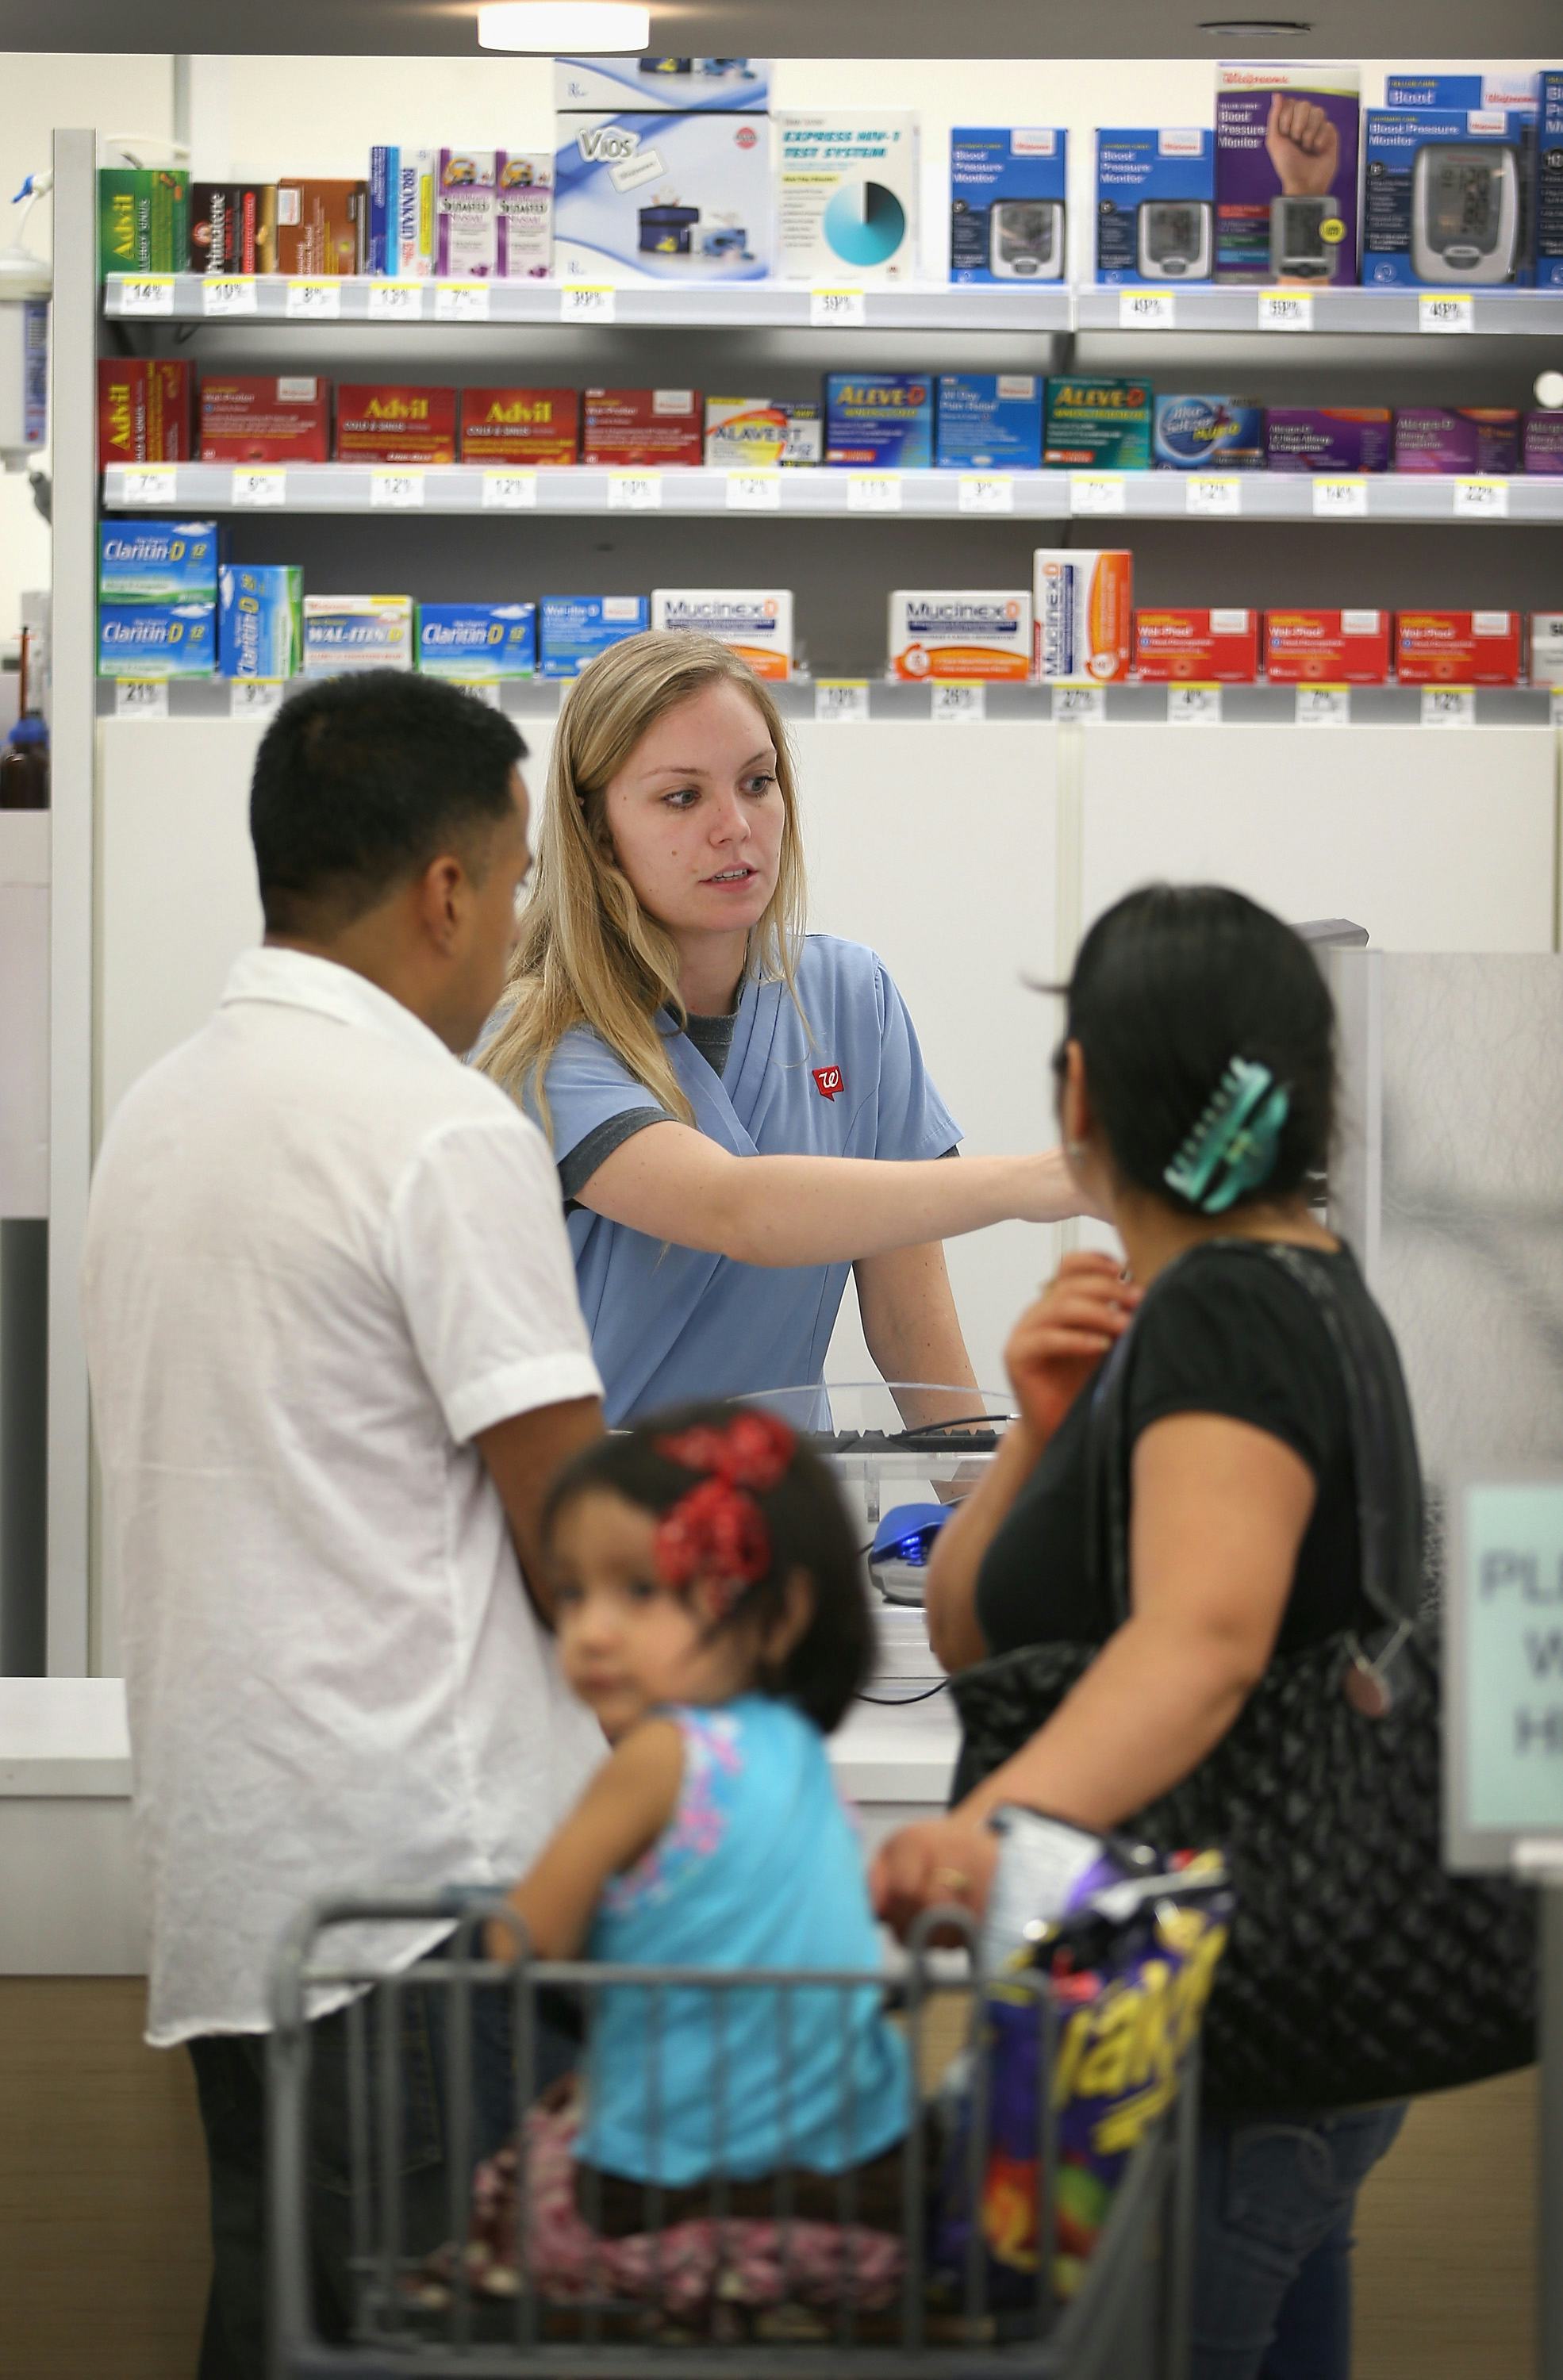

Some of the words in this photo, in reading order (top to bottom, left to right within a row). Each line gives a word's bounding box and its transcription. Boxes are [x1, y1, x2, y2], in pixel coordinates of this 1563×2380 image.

[784, 131, 852, 142] EXPRESS
[785, 148, 819, 158] TEST
[113, 194, 135, 260] Advil
[108, 384, 131, 451] Advil
[363, 397, 429, 420] Advil
[485, 401, 553, 424] Advil
[714, 425, 803, 443] ALAVERT
